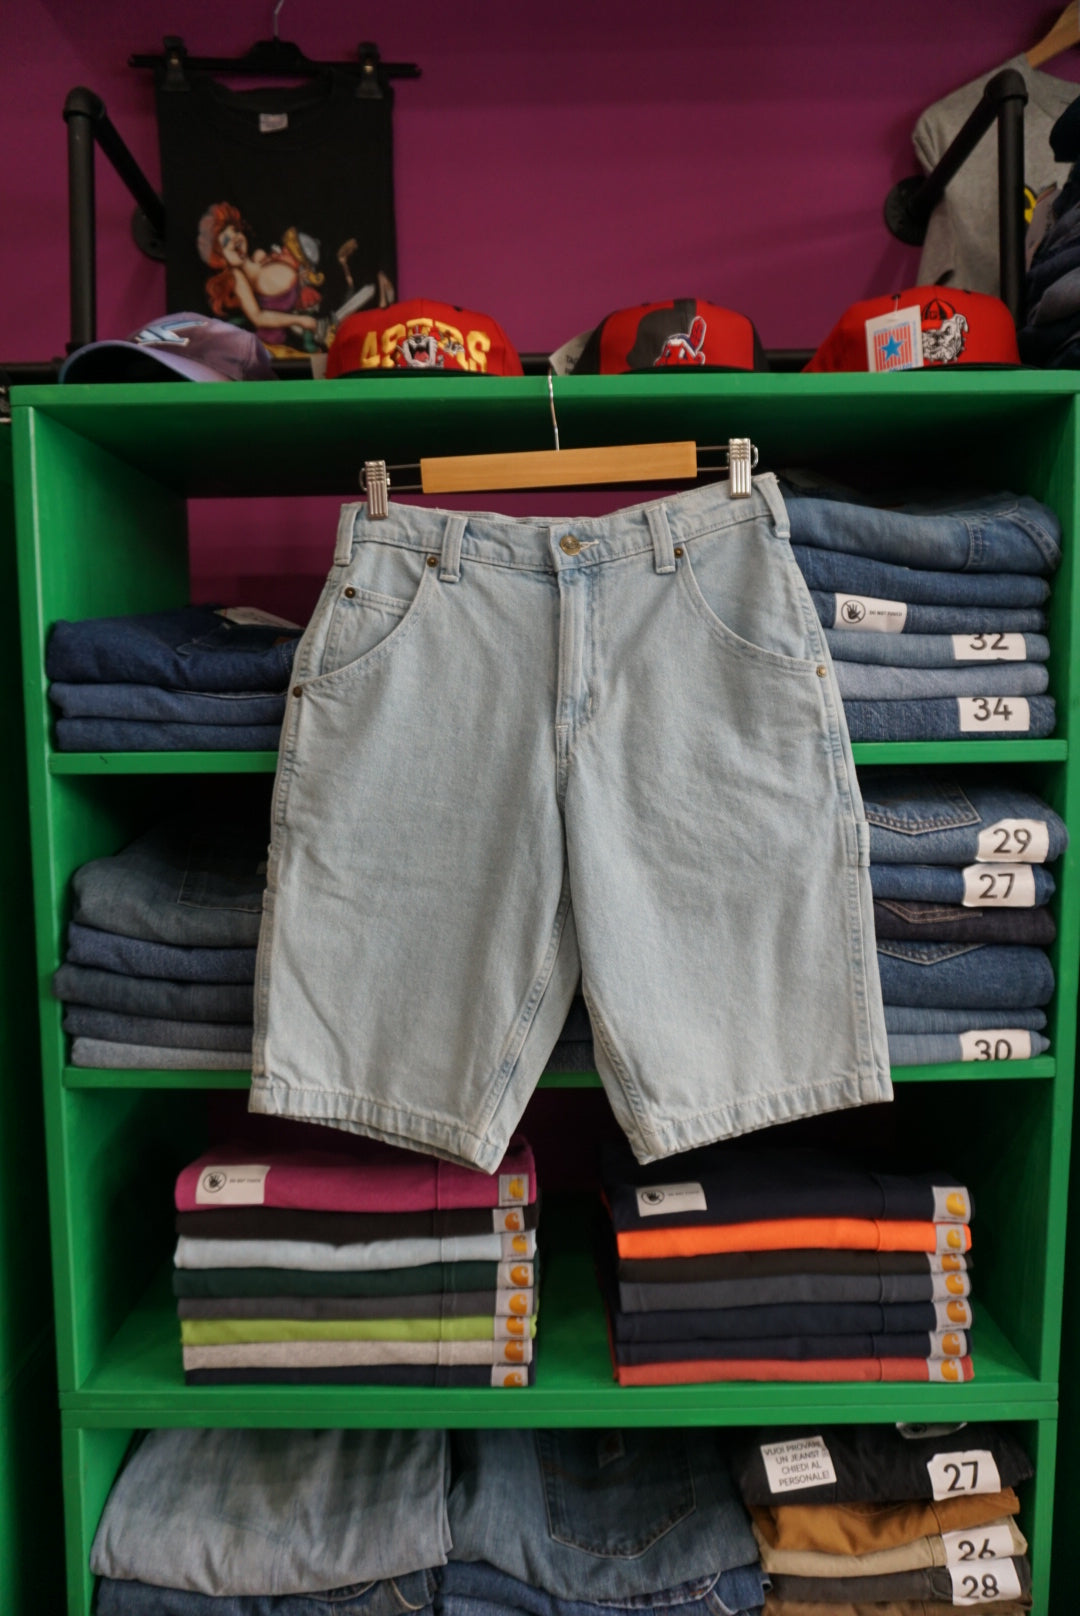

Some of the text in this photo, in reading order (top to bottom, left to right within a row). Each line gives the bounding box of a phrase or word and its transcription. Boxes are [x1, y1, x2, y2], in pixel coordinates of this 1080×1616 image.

[969, 632, 1009, 651] 32
[972, 697, 1013, 722] 34
[993, 828, 1032, 854] 29
[979, 872, 1016, 899] 27
[974, 1039, 1012, 1061] 30
[775, 1455, 788, 1465] UN
[811, 1461, 822, 1469] AL
[943, 1461, 979, 1492] 27
[958, 1538, 996, 1561] 26
[962, 1574, 1000, 1599] 28
